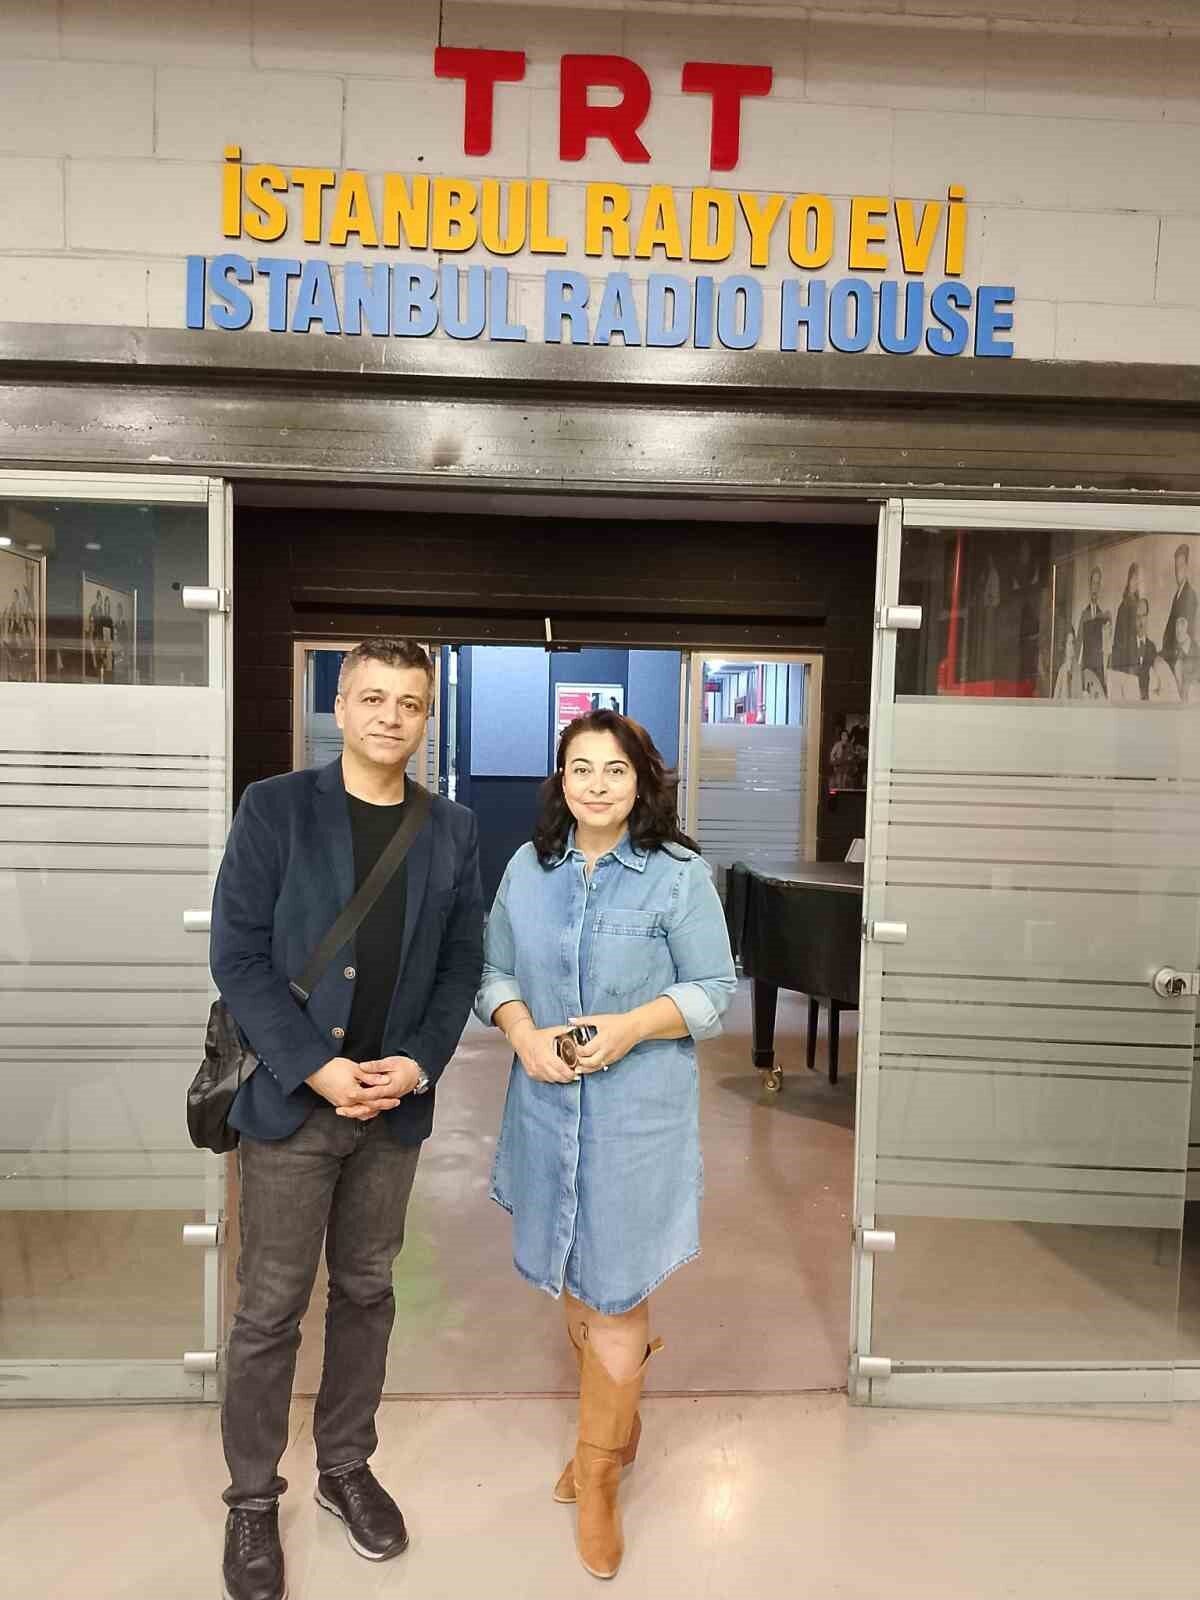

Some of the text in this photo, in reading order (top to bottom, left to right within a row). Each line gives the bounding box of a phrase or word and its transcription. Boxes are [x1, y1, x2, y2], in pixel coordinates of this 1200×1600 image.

[434, 45, 774, 171] TRT
[222, 145, 967, 276] İSTANBUL RADYO EVİ
[186, 253, 1017, 358] ISTANBUL RADIO HOUSE
